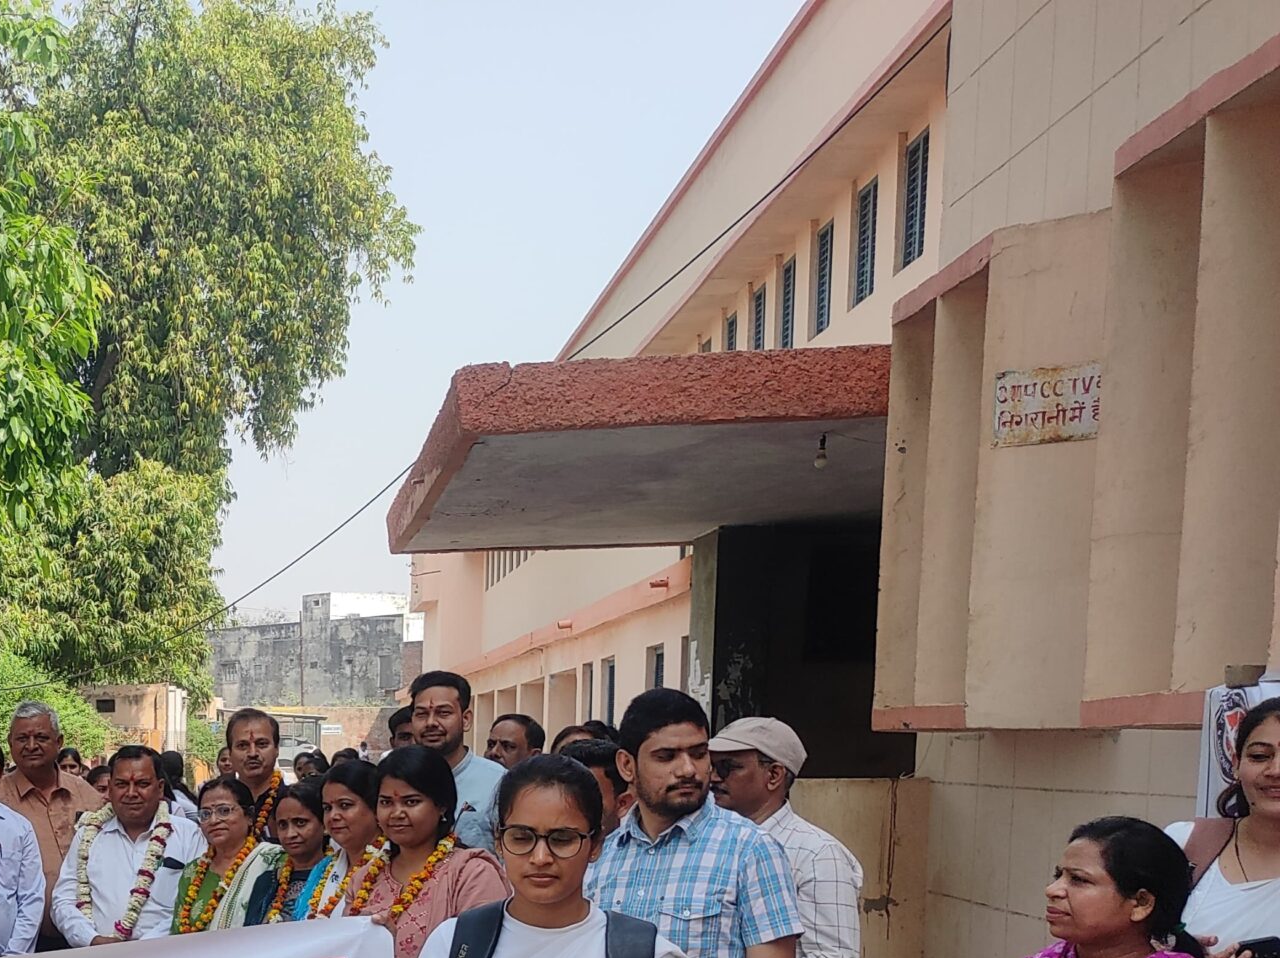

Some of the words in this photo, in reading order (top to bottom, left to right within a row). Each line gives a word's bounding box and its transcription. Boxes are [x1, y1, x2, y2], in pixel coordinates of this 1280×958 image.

[1040, 376, 1094, 398] CCTV
[997, 403, 1068, 432] निगरानी
[1069, 400, 1086, 424] में
